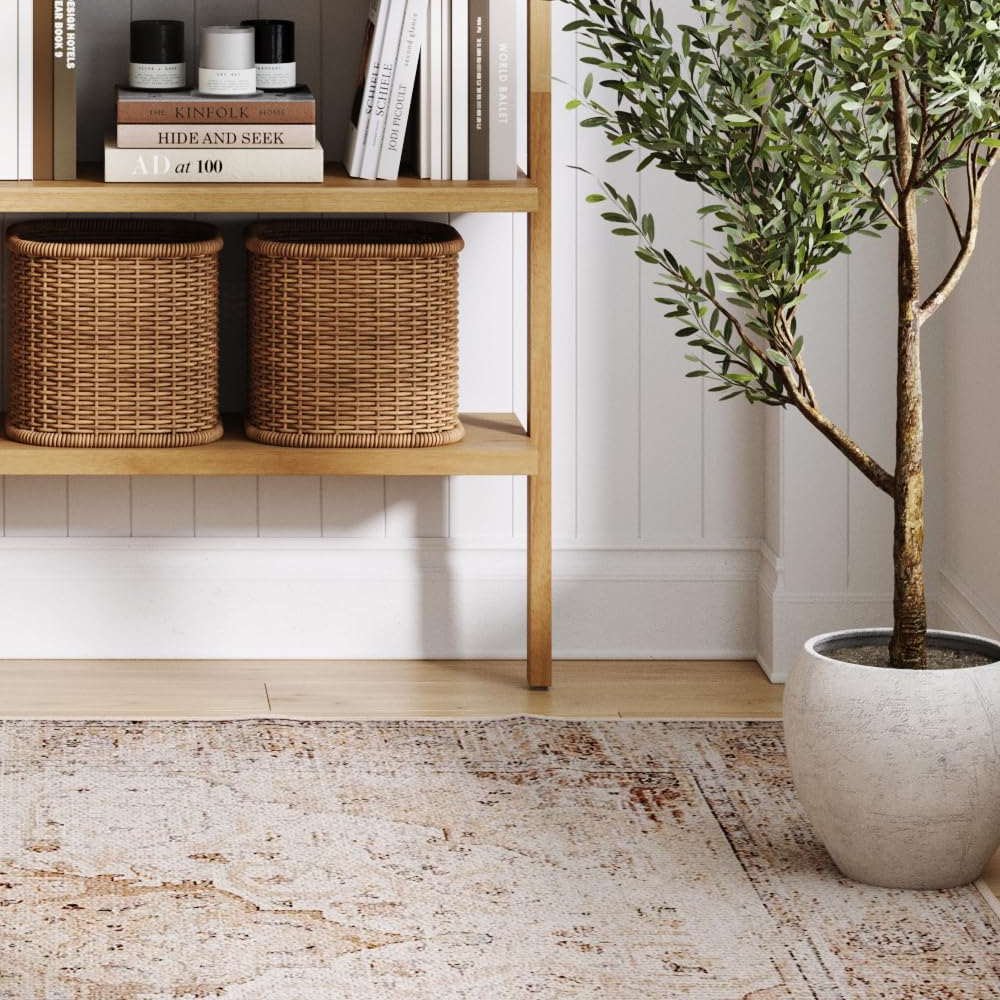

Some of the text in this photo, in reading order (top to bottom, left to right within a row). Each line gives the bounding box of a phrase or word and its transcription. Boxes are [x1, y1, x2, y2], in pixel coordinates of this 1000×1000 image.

[54, 22, 63, 49] BOOK
[66, 33, 75, 69] HOTELS
[404, 39, 414, 67] second
[376, 63, 392, 117] SCHIELE
[498, 42, 508, 124] WORLD BALLET
[175, 106, 250, 118] KINFOLK
[389, 84, 407, 151] JODI PICOULT
[158, 132, 285, 145] HIDE AND SEEK
[132, 155, 223, 175] AD at 100
